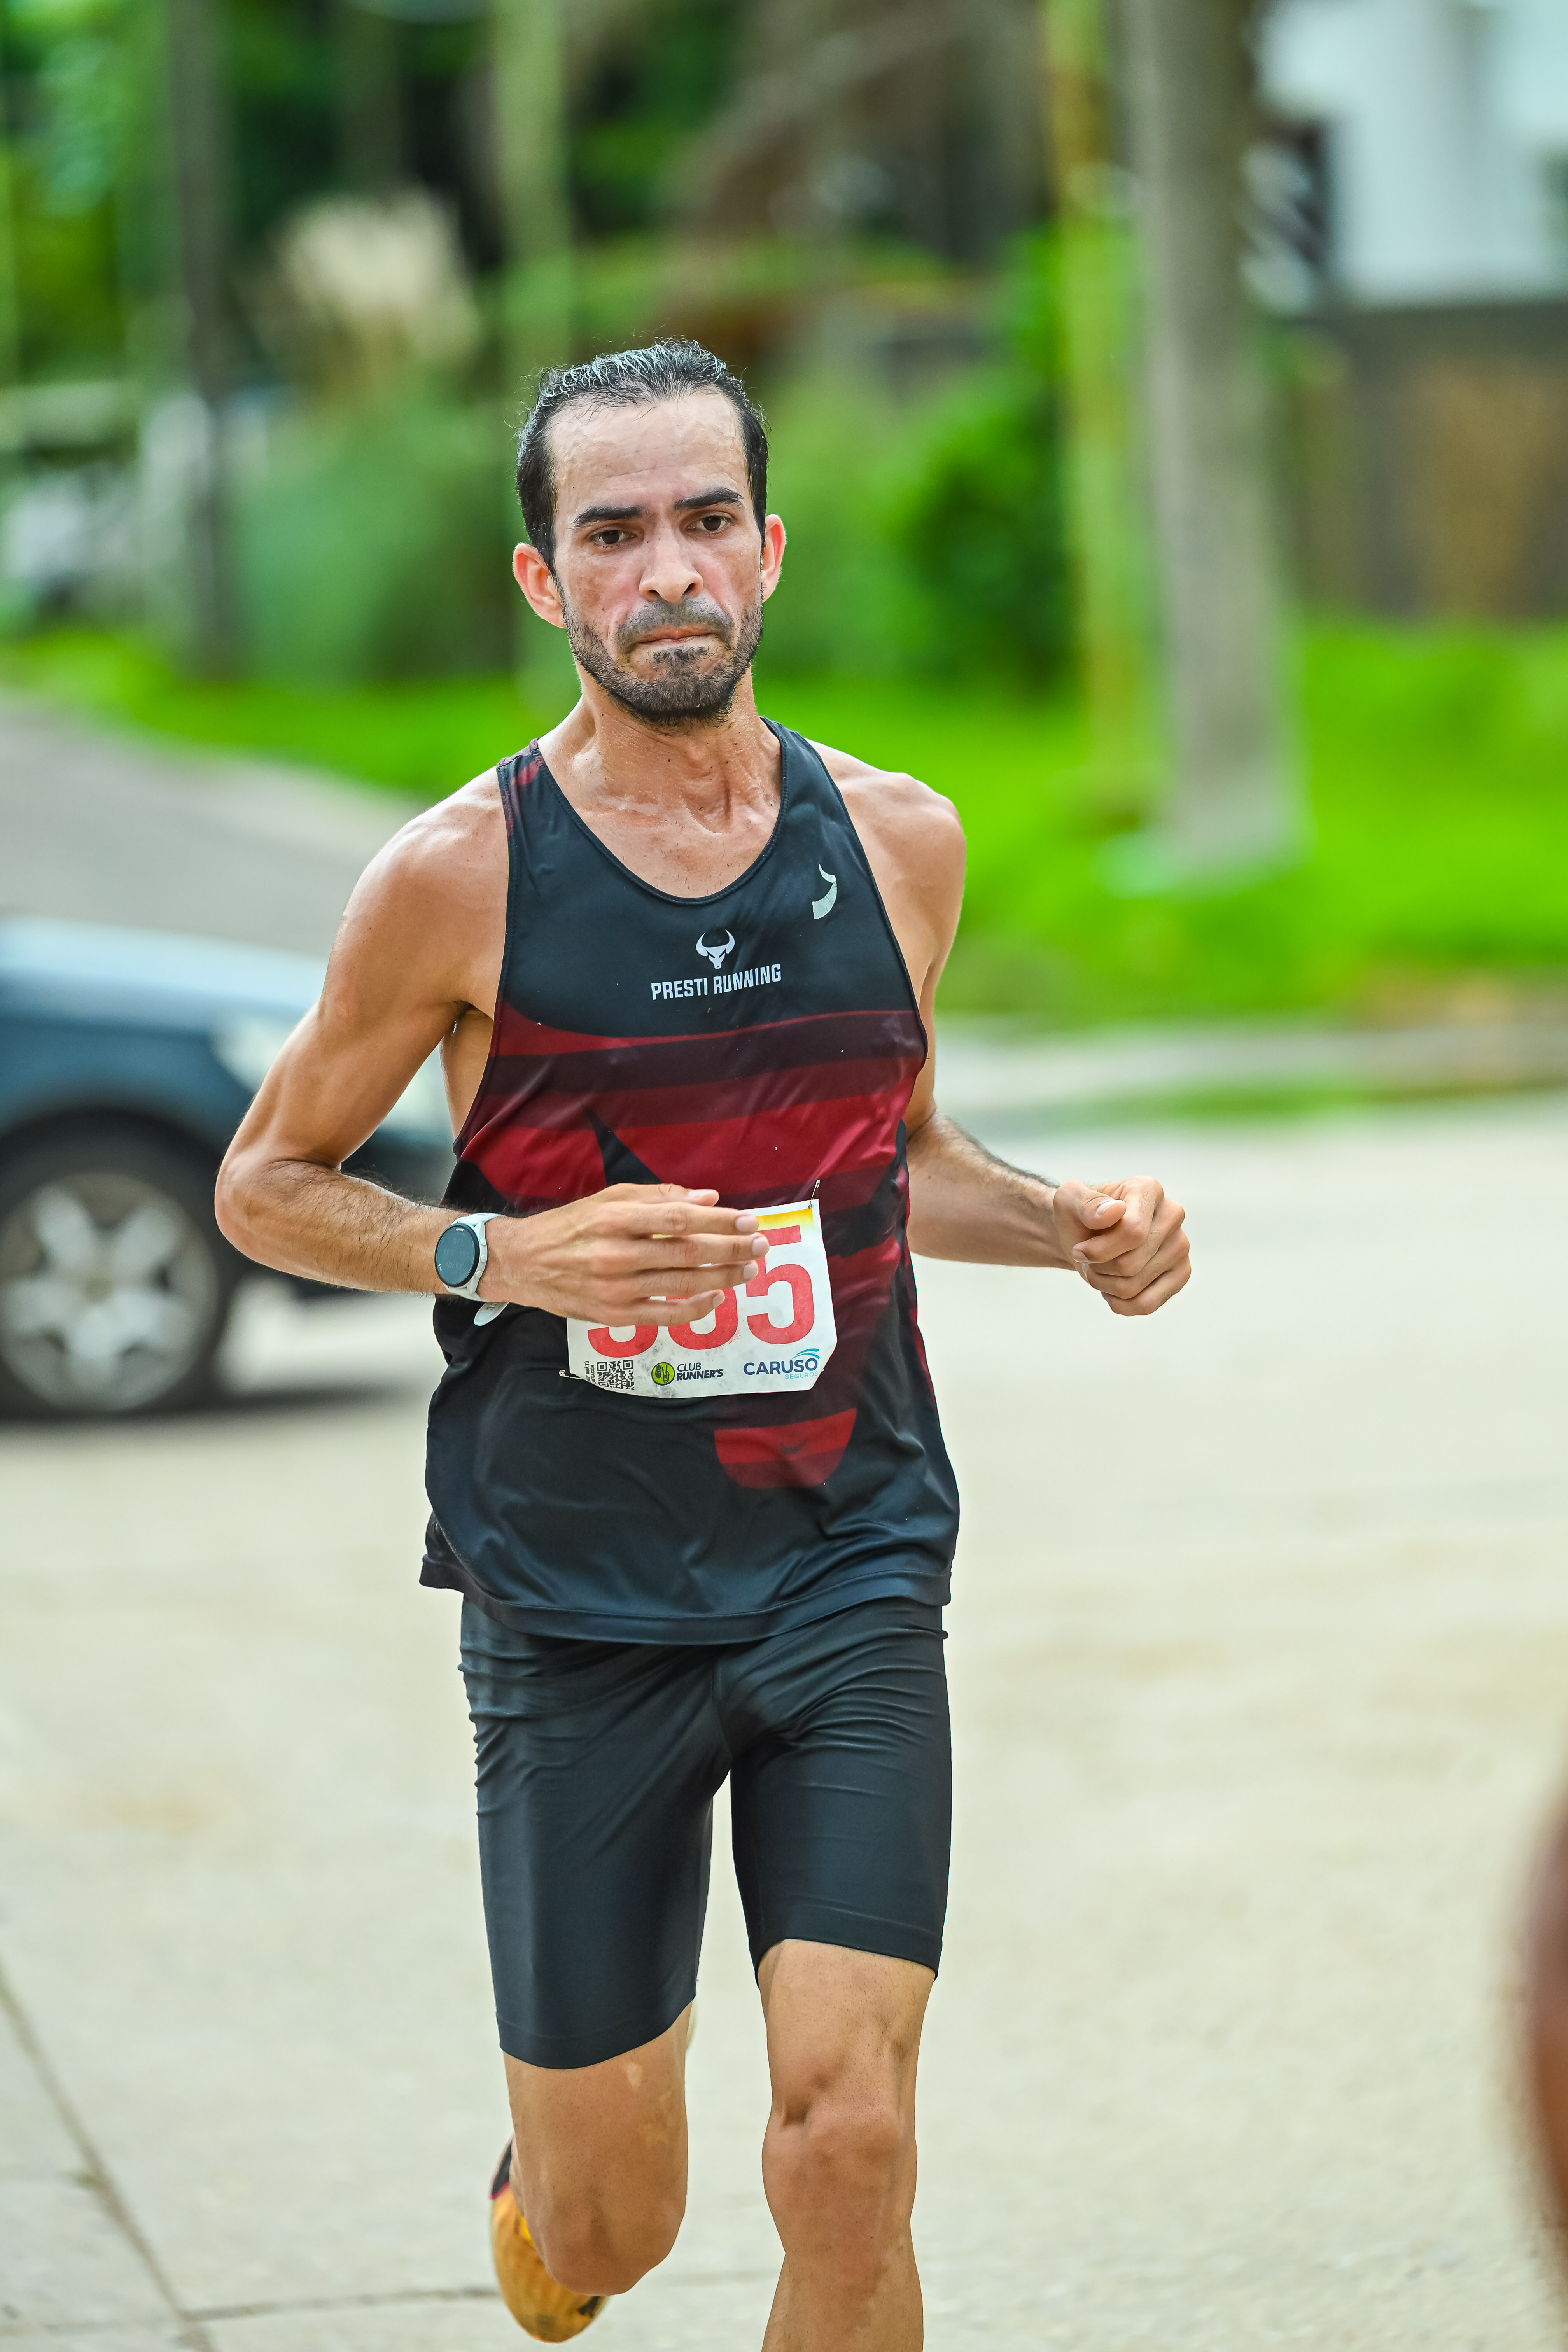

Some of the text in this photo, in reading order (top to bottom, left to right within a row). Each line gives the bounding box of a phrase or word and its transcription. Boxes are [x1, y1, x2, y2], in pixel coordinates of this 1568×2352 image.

[651, 963, 782, 1000] PRESTI RUNNING
[677, 1362, 701, 1370] CLUB
[743, 1358, 818, 1375] CARUSO
[676, 1369, 723, 1381] RUNNER'S
[785, 1371, 818, 1379] SEGUROS
